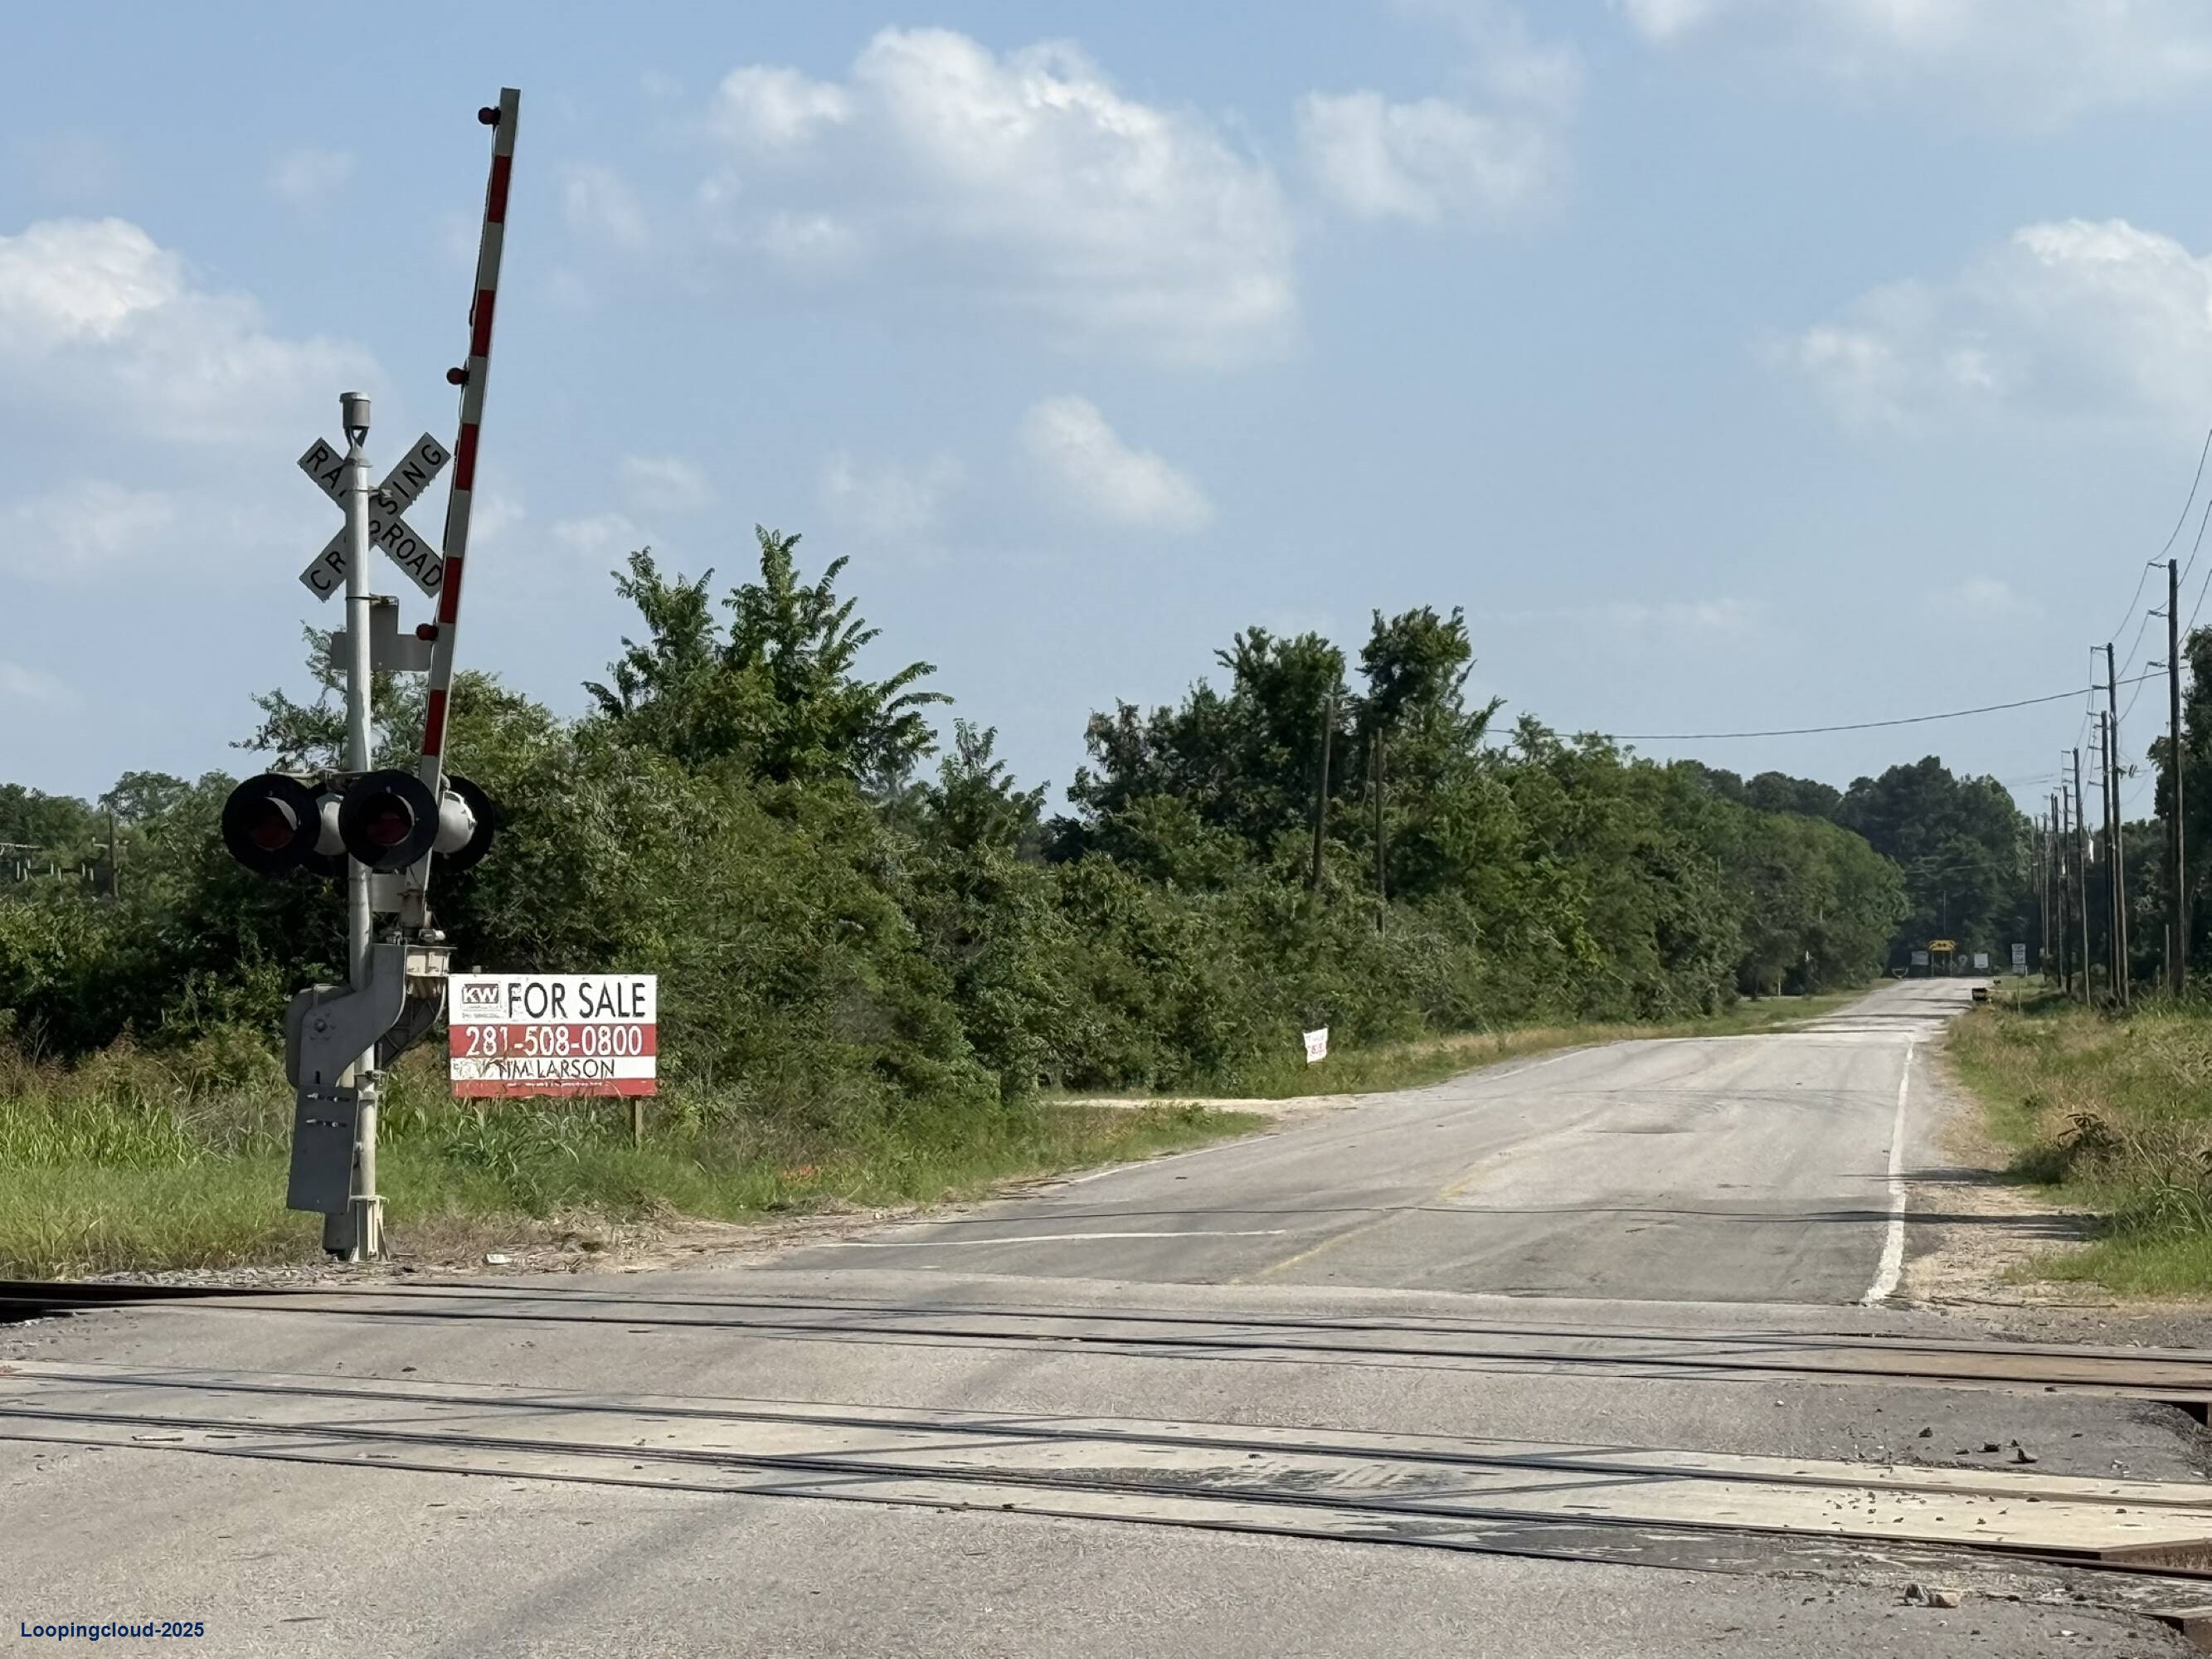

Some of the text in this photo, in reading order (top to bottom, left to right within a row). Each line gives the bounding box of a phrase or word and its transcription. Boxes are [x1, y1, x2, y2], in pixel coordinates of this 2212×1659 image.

[310, 444, 441, 591] CRSING
[464, 987, 498, 1003] KW
[508, 982, 646, 1019] FOR SALE
[466, 1025, 643, 1057] 281-508-0800
[537, 1058, 615, 1078] LARSON
